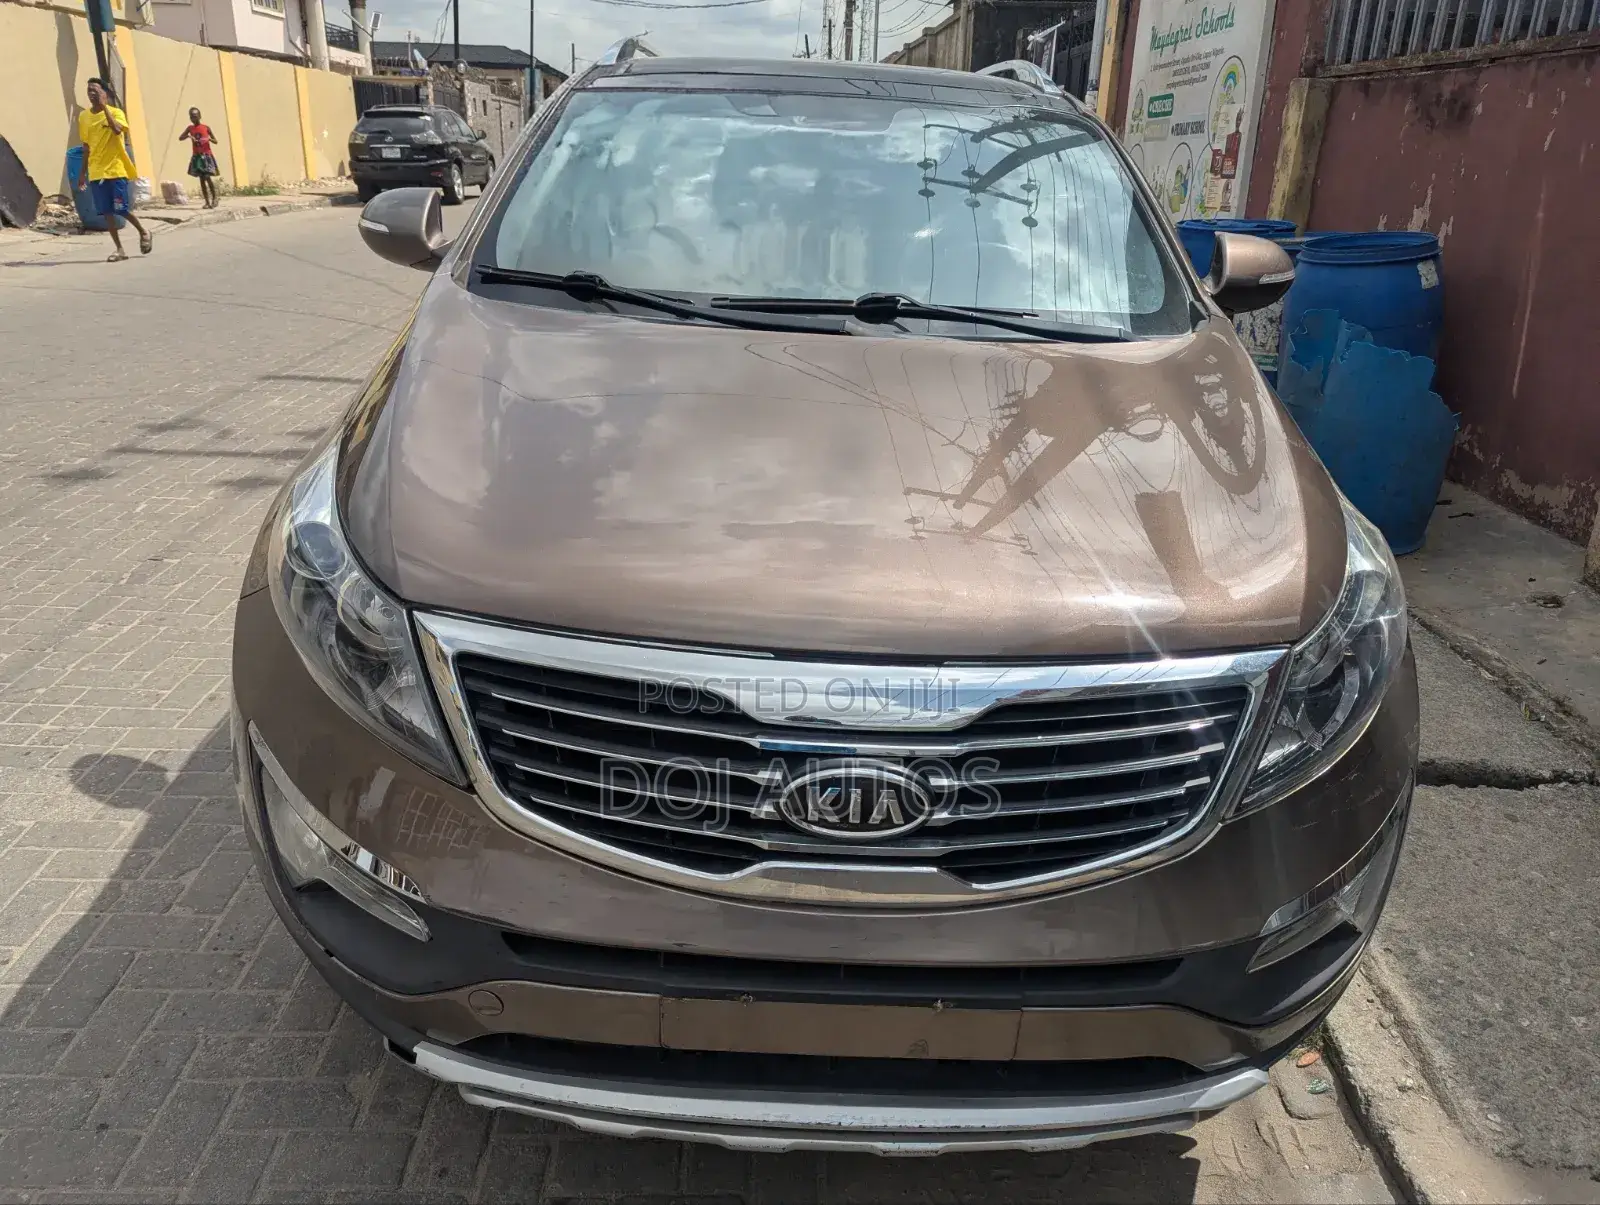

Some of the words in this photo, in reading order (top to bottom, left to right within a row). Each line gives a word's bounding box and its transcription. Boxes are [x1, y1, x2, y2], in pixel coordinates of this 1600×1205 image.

[1195, 2, 1235, 38] Schools
[1190, 120, 1206, 135] SCHOOL
[807, 786, 905, 826] KIA
